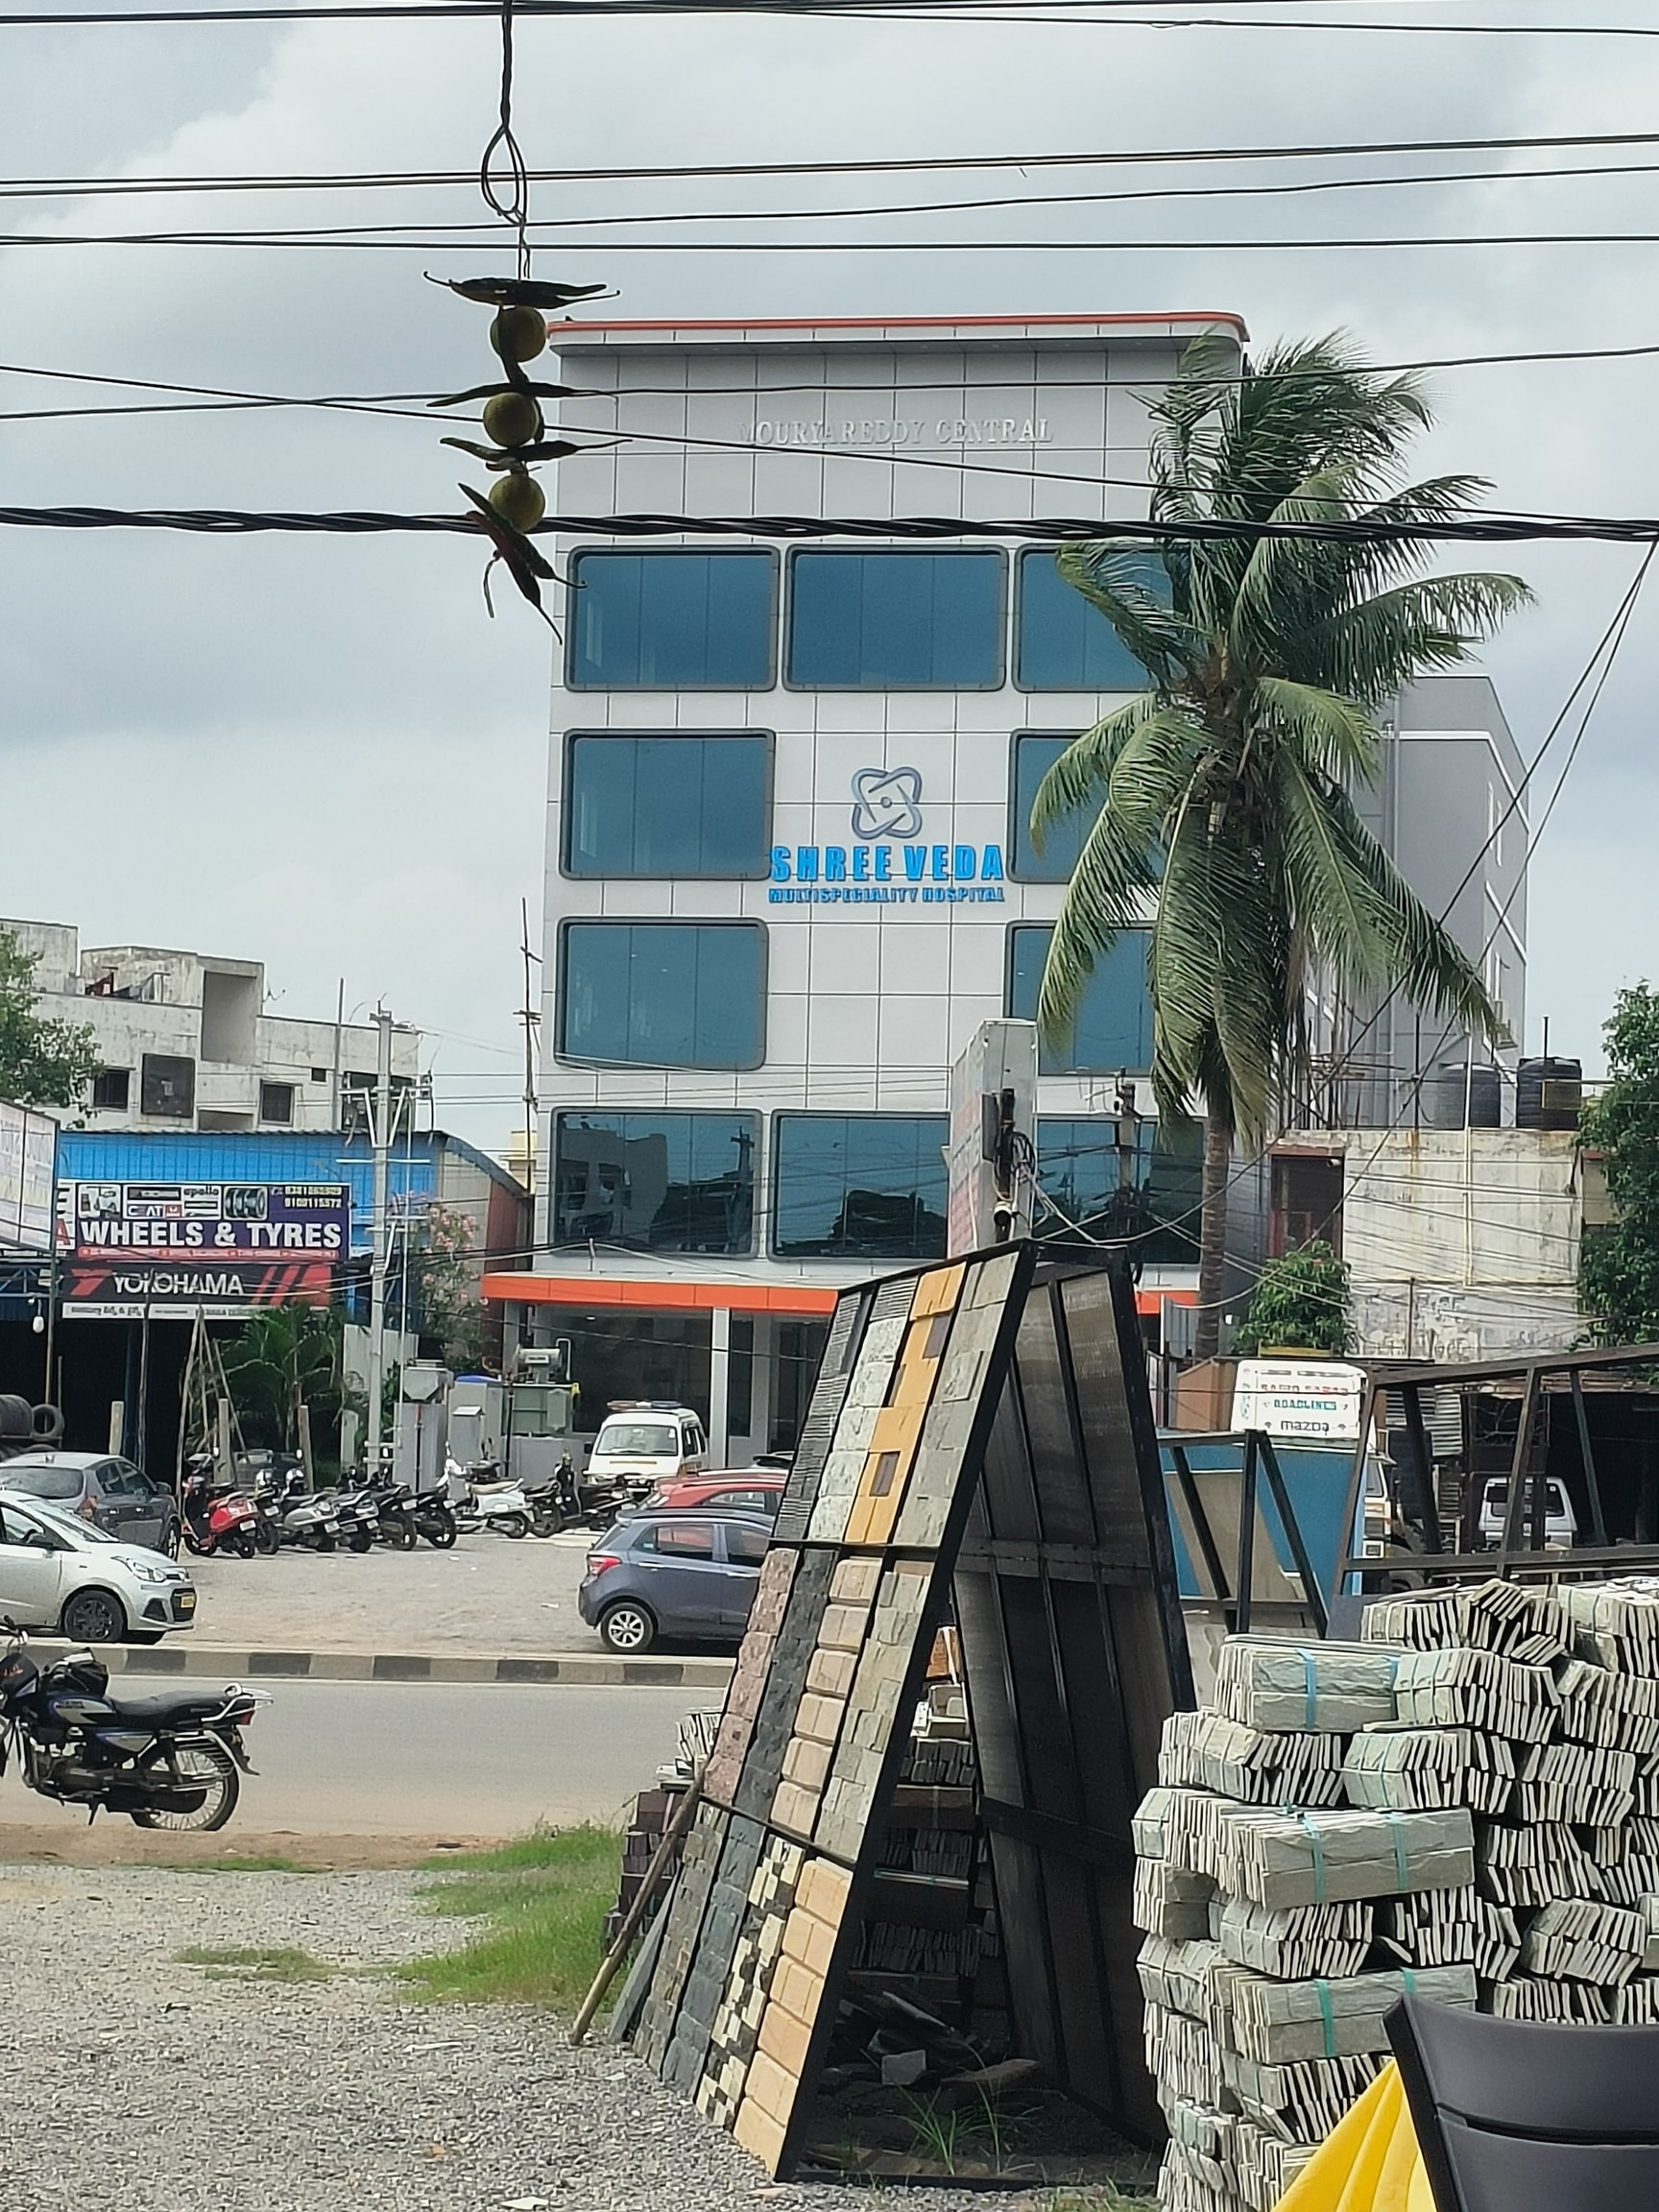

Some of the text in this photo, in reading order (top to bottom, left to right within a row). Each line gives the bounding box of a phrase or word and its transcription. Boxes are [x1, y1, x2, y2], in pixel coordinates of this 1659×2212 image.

[840, 420, 925, 445] REDDY
[936, 419, 1054, 444] CENTRAL
[770, 845, 1004, 882] SHREE VEDA
[768, 887, 1005, 903] MULTISPECIALITY HOSPITAL
[183, 1186, 220, 1198] apollo
[81, 1221, 342, 1247] WHEELS & TYRES
[112, 1272, 245, 1295] YOKOHAMA
